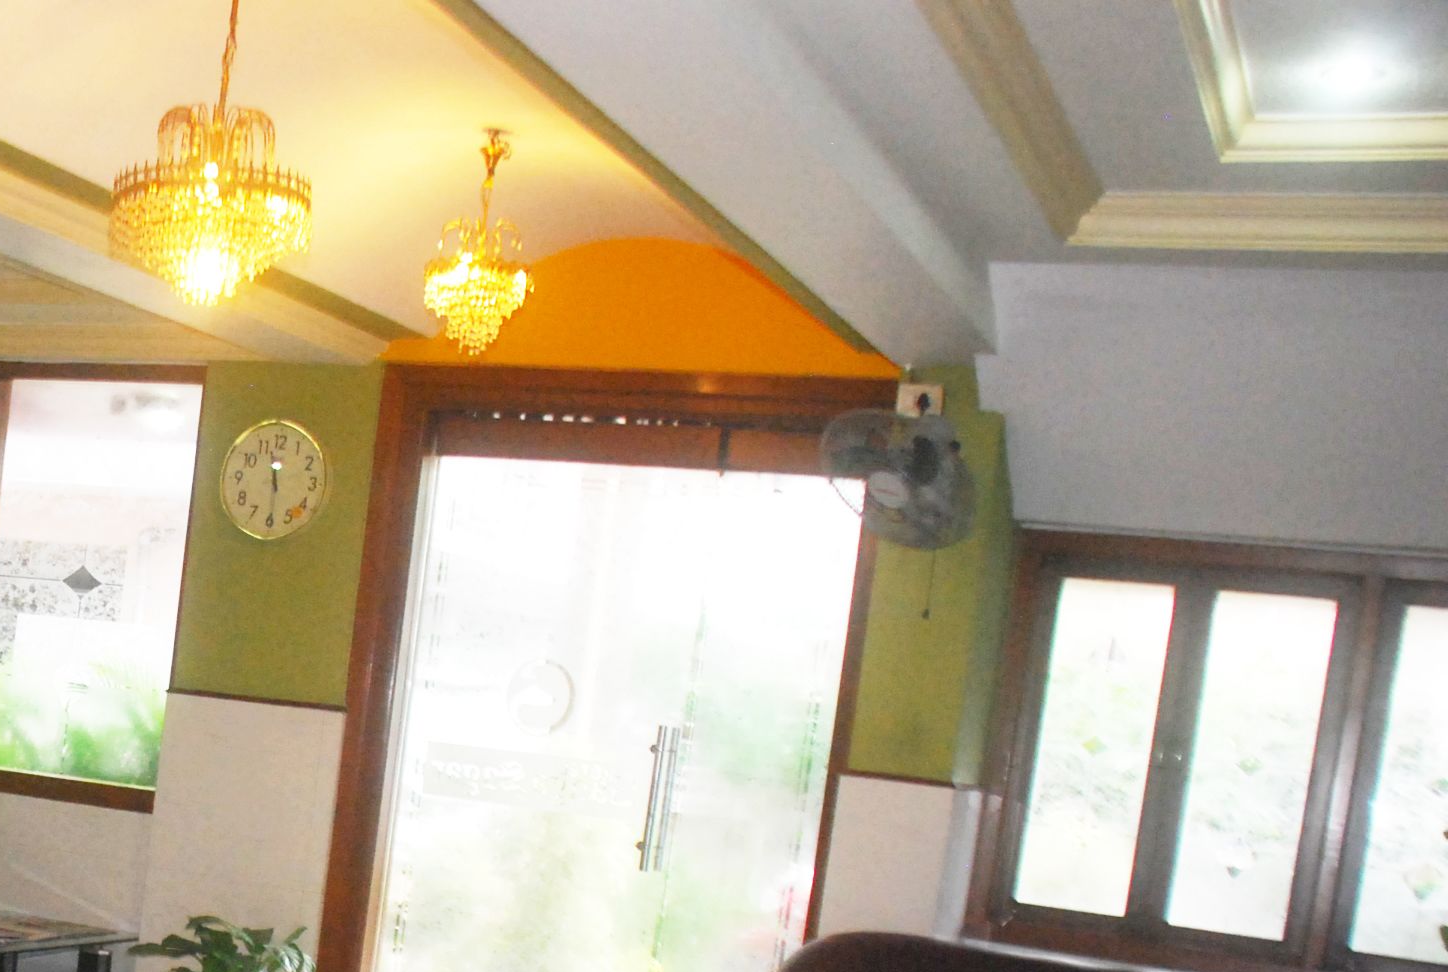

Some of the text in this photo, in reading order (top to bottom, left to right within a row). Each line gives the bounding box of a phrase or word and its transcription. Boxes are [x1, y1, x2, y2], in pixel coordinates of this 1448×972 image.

[258, 440, 269, 455] 11
[274, 434, 287, 450] 12
[295, 441, 300, 456] 1
[244, 453, 257, 468] 10
[304, 456, 314, 471] 2
[235, 470, 243, 485] 9
[308, 477, 317, 491] 3
[238, 491, 246, 506] 8
[299, 497, 307, 512] 4
[250, 505, 259, 520] 7
[265, 512, 274, 528] 6
[283, 509, 293, 524] 5
